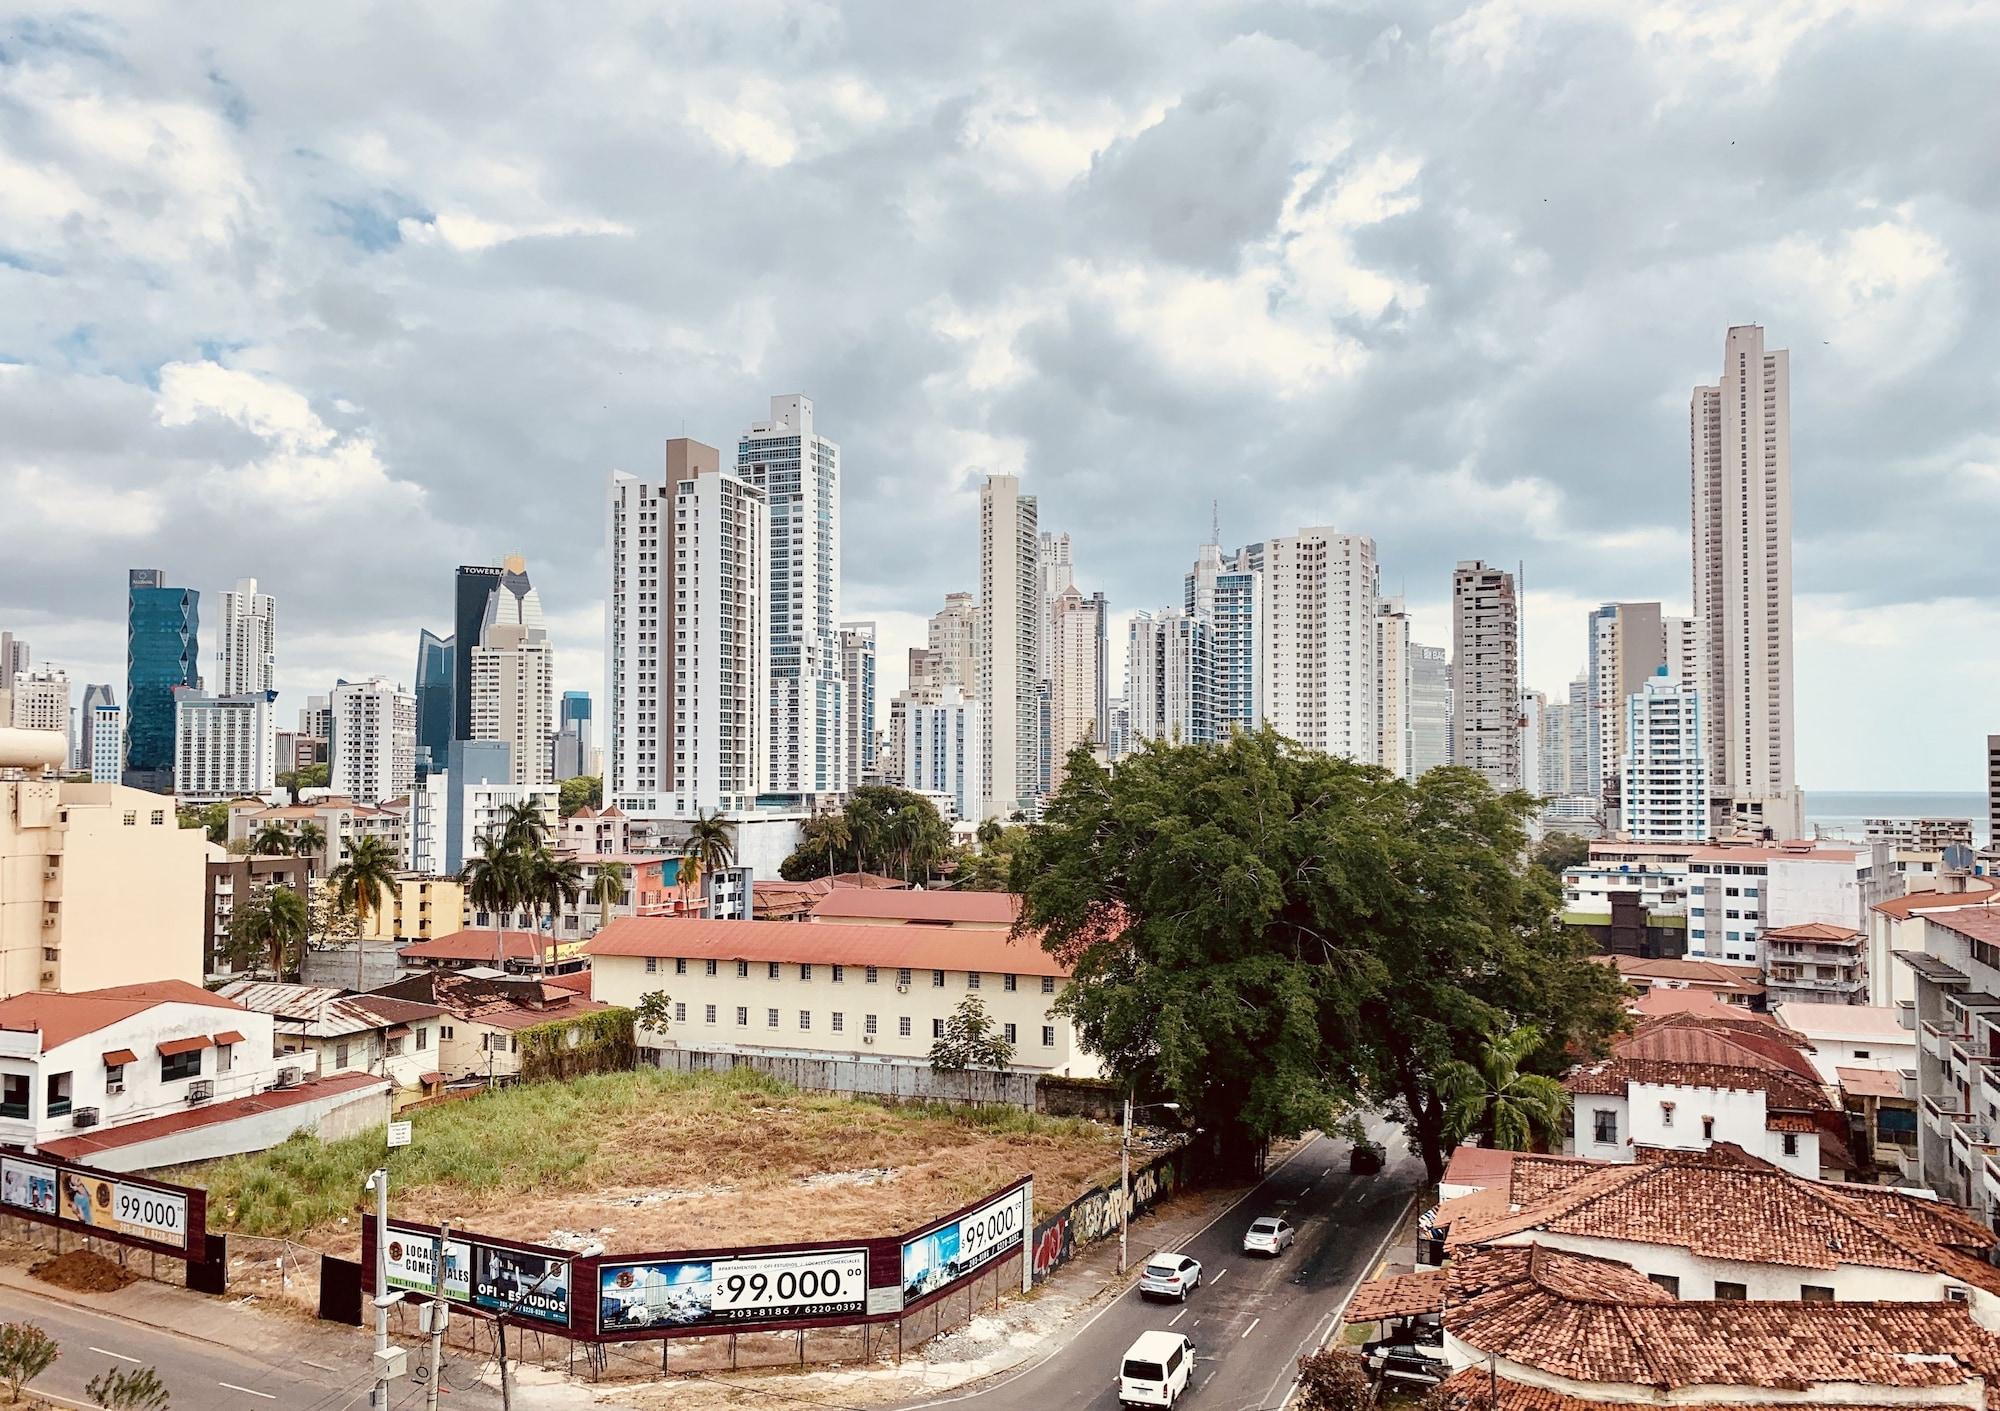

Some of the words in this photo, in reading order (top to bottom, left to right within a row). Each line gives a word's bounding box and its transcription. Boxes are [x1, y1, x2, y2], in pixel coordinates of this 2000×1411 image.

[406, 1244, 438, 1262] LOCALE
[405, 1259, 469, 1283] COMERALES
[477, 1283, 497, 1297] OFI
[729, 1307, 790, 1319] 203-8186
[804, 1302, 862, 1315] 6220-0392
